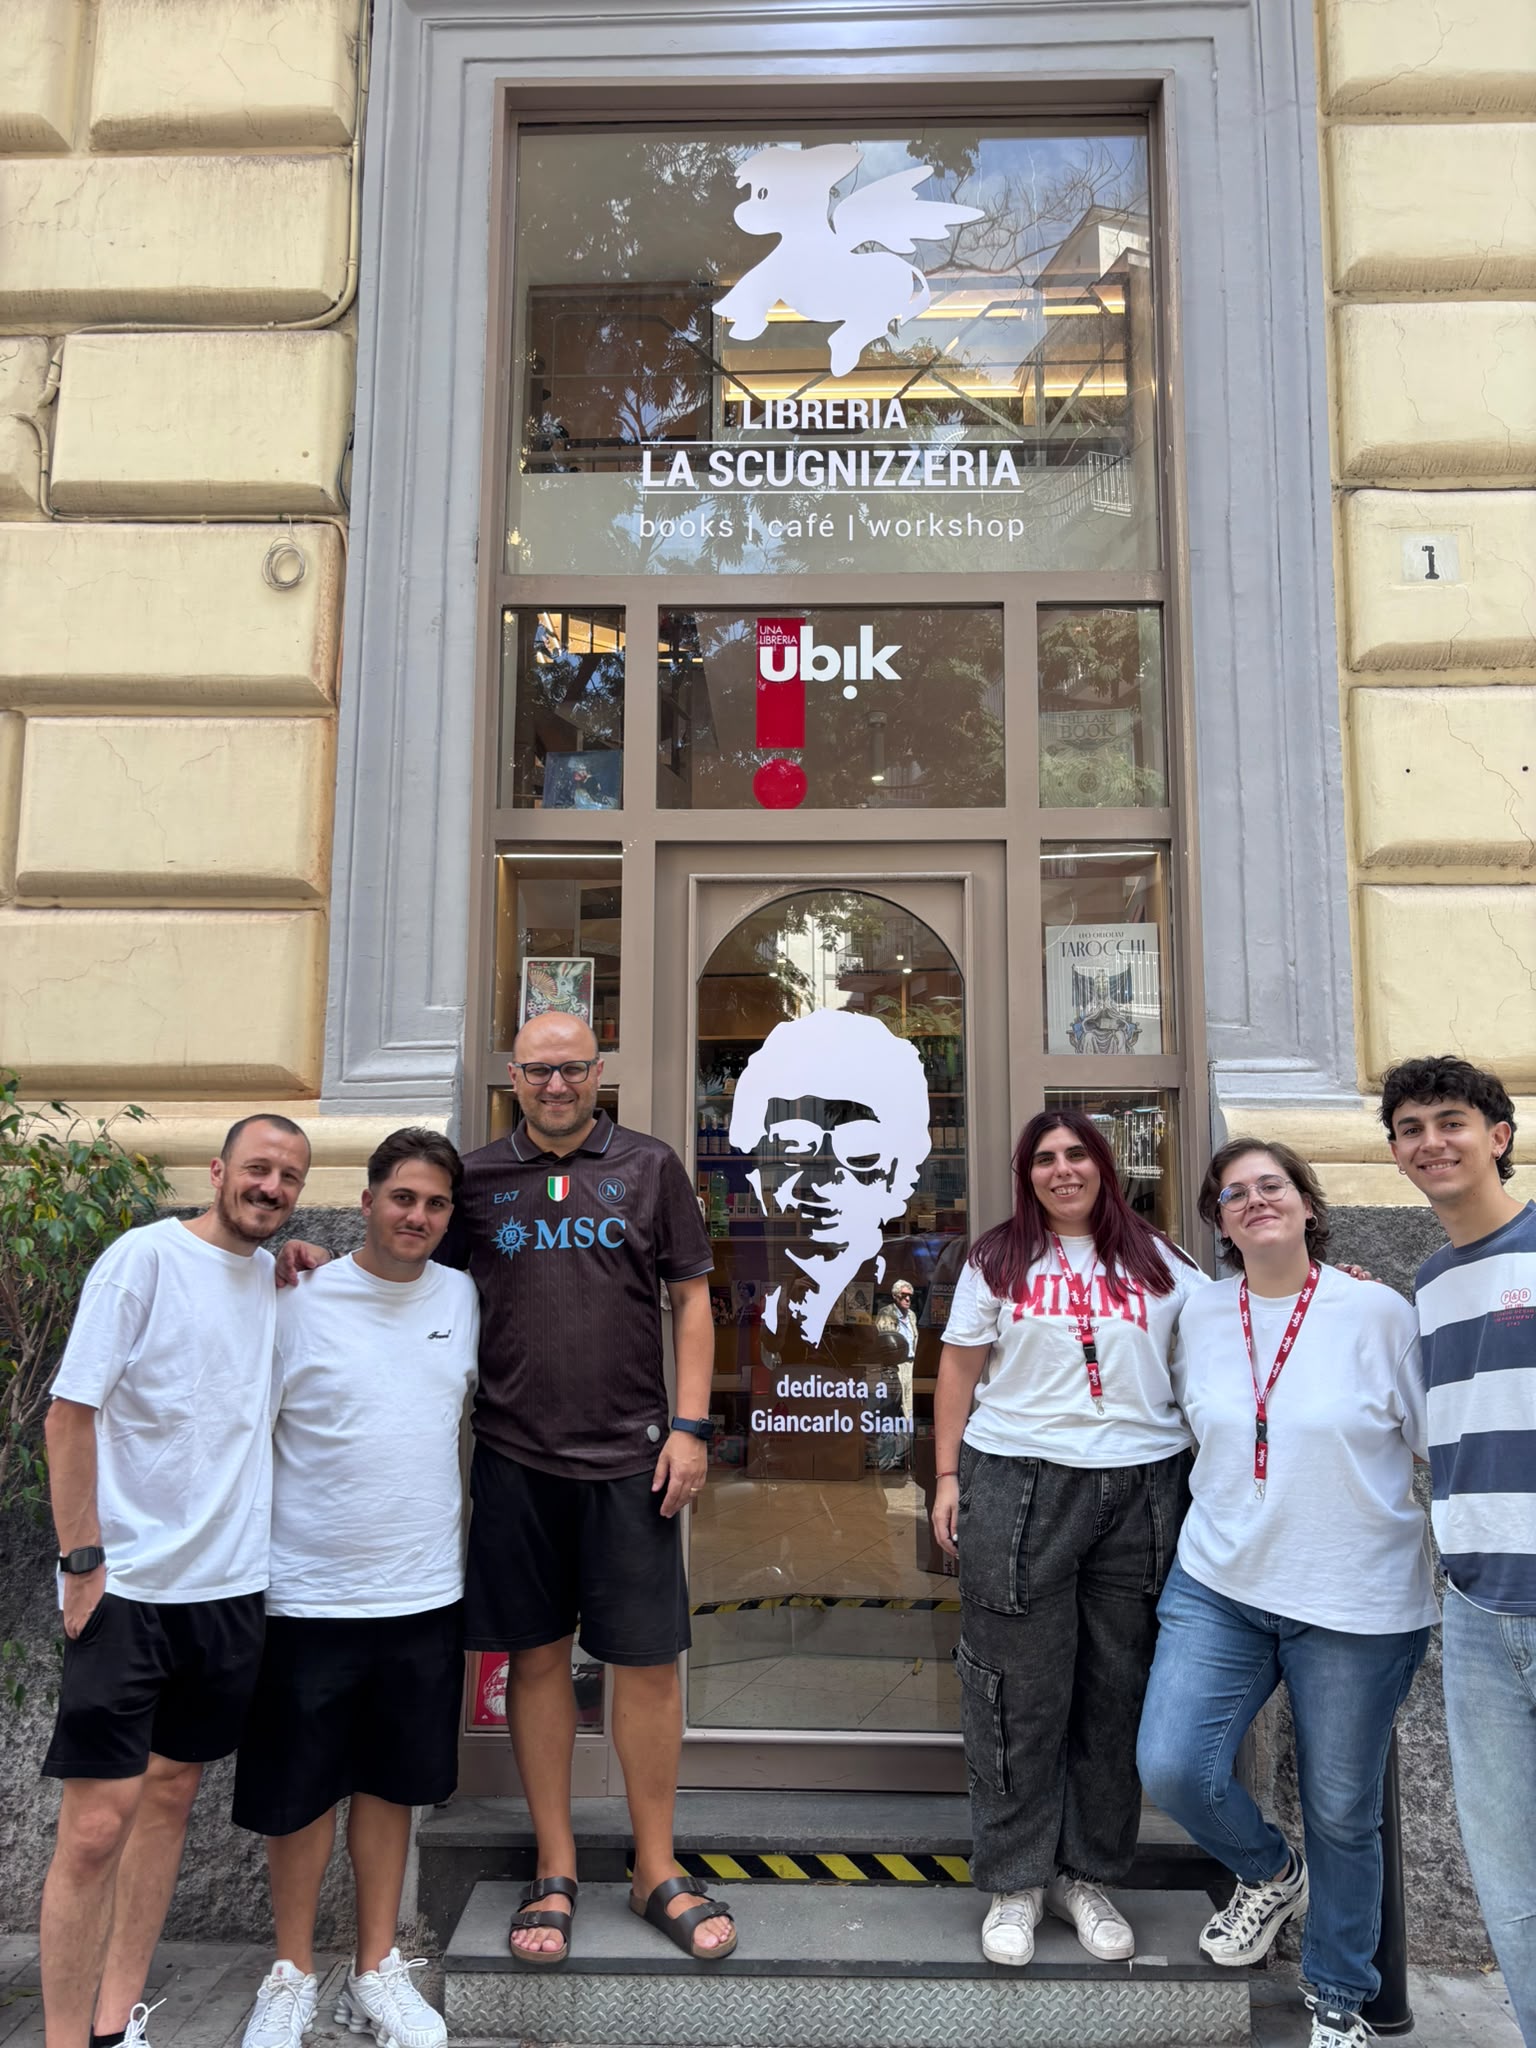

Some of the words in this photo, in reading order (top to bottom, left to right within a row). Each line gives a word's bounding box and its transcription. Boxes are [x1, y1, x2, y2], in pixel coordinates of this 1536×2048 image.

[743, 398, 908, 430] LIBRERIA
[642, 449, 695, 487] LA
[708, 449, 1021, 487] SCUGNIZZERIA
[640, 513, 733, 538] books
[768, 512, 834, 538] café
[868, 512, 1024, 542] workshop
[1421, 545, 1440, 580] 1
[759, 625, 783, 634] UNA
[759, 635, 798, 645] LIBRERIA
[759, 625, 903, 700] ubik
[1061, 723, 1117, 739] BOOK
[1062, 715, 1083, 724] THE
[1087, 714, 1113, 723] LAST
[1059, 939, 1145, 958] TAROCCHI
[494, 1190, 520, 1205] EA7
[534, 1216, 626, 1250] MSC
[776, 1374, 868, 1399] dedicata
[875, 1381, 888, 1399] a
[751, 1409, 853, 1433] Giancarlo
[860, 1410, 914, 1434] Siani
